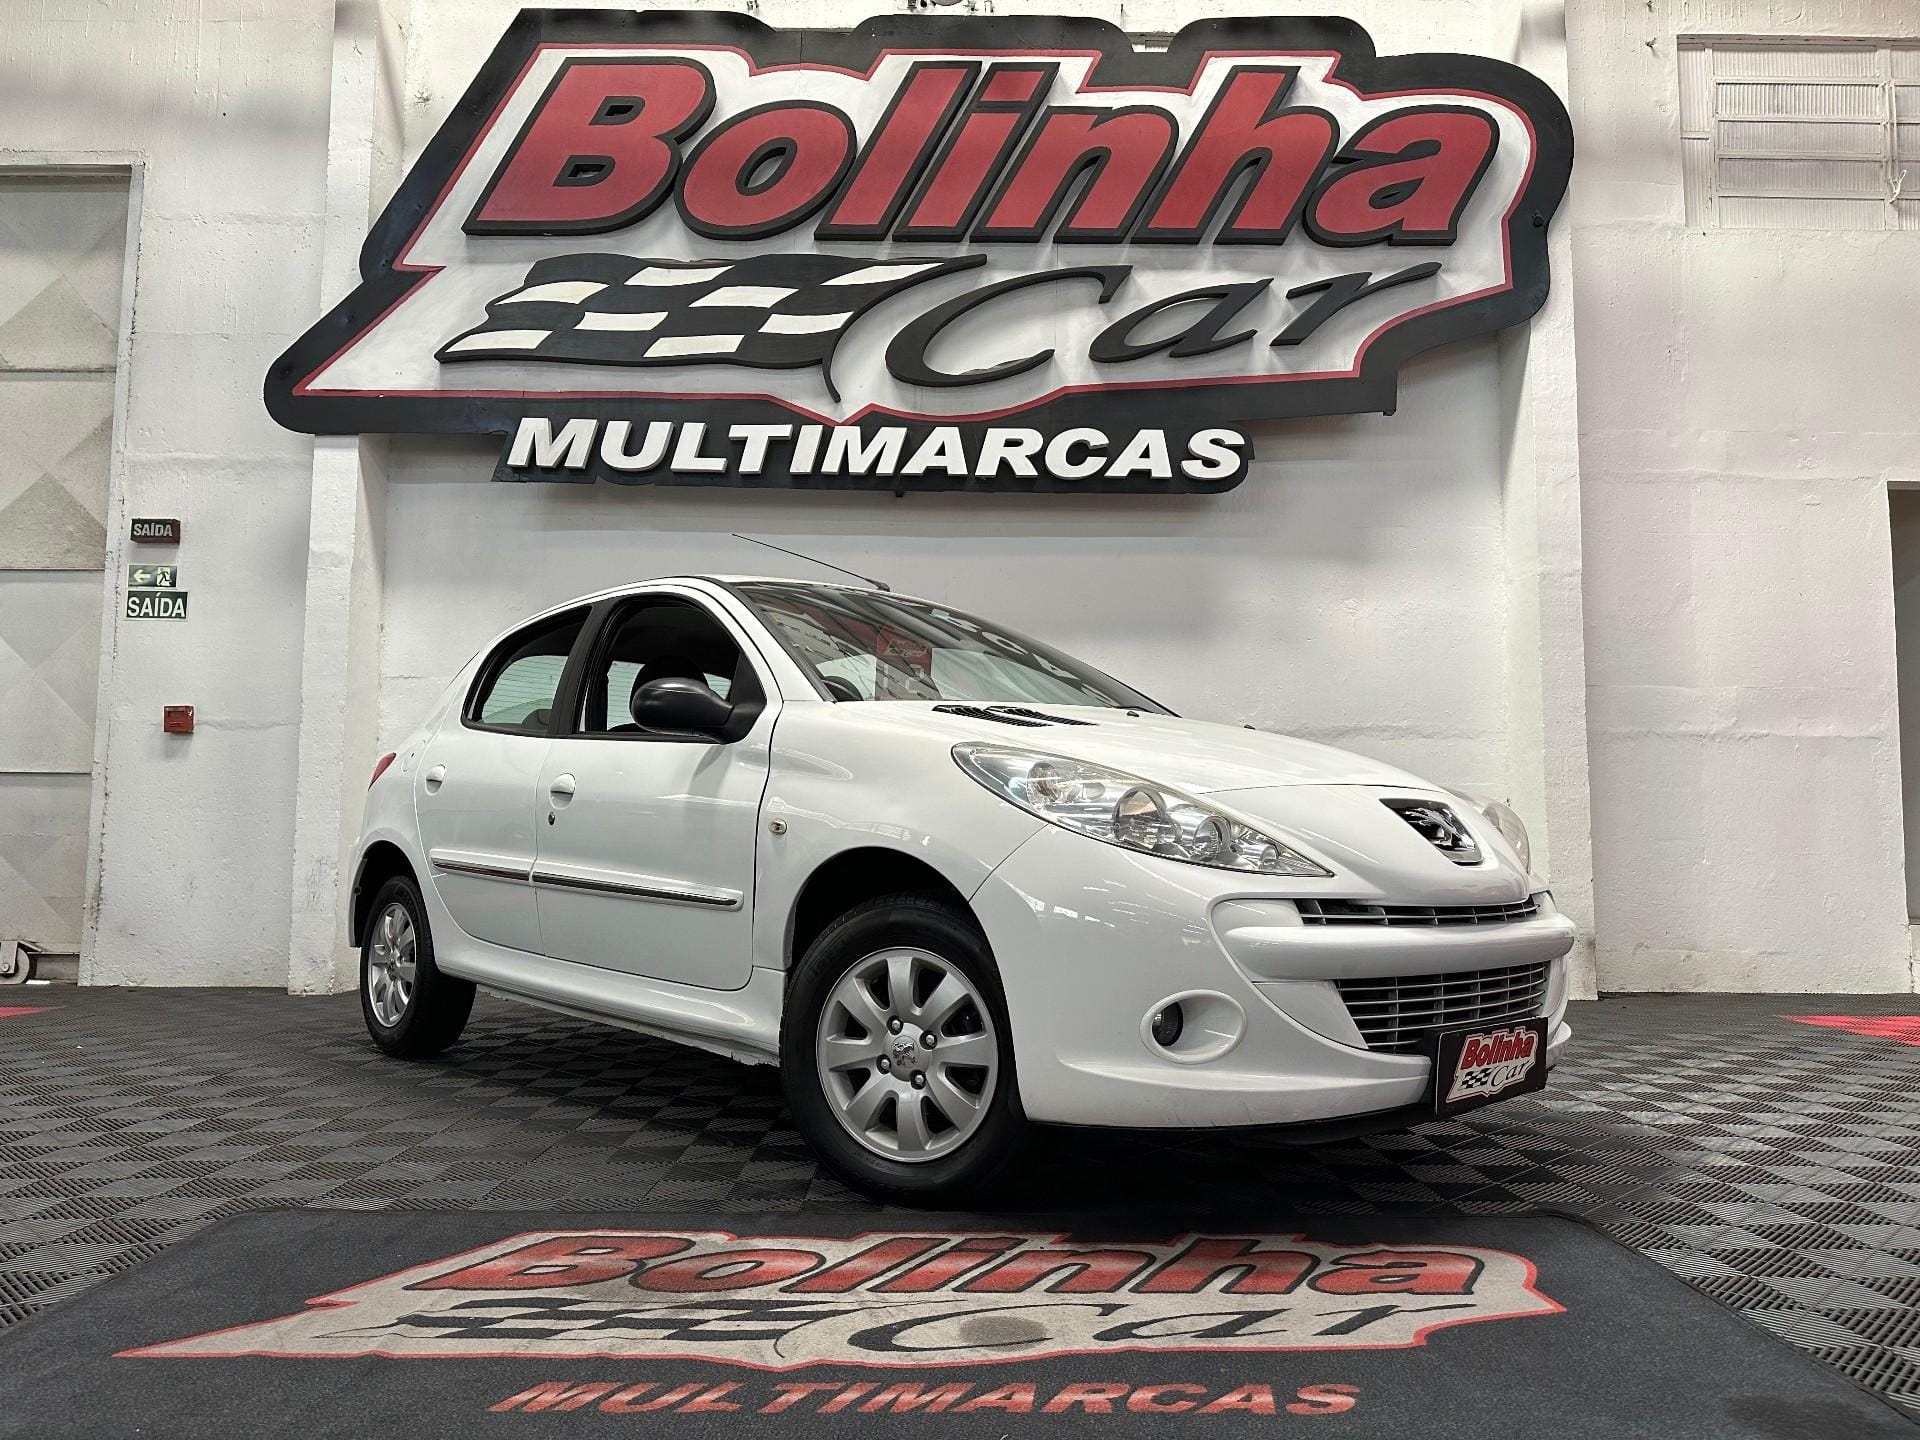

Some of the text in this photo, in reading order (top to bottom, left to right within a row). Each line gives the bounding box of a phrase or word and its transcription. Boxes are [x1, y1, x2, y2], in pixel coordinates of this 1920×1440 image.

[462, 57, 1500, 245] Bolinha
[884, 262, 1443, 387] Car
[507, 417, 1246, 480] MULTIMARCAS
[133, 523, 172, 536] SAÍDA
[127, 592, 186, 617] SAÍDA
[1461, 1032, 1534, 1070] Bolinha
[1491, 1060, 1529, 1086] Car
[403, 1236, 1486, 1295] Bolinha
[848, 1303, 1478, 1351] Car
[487, 1381, 1362, 1415] MULTIMARCAS
